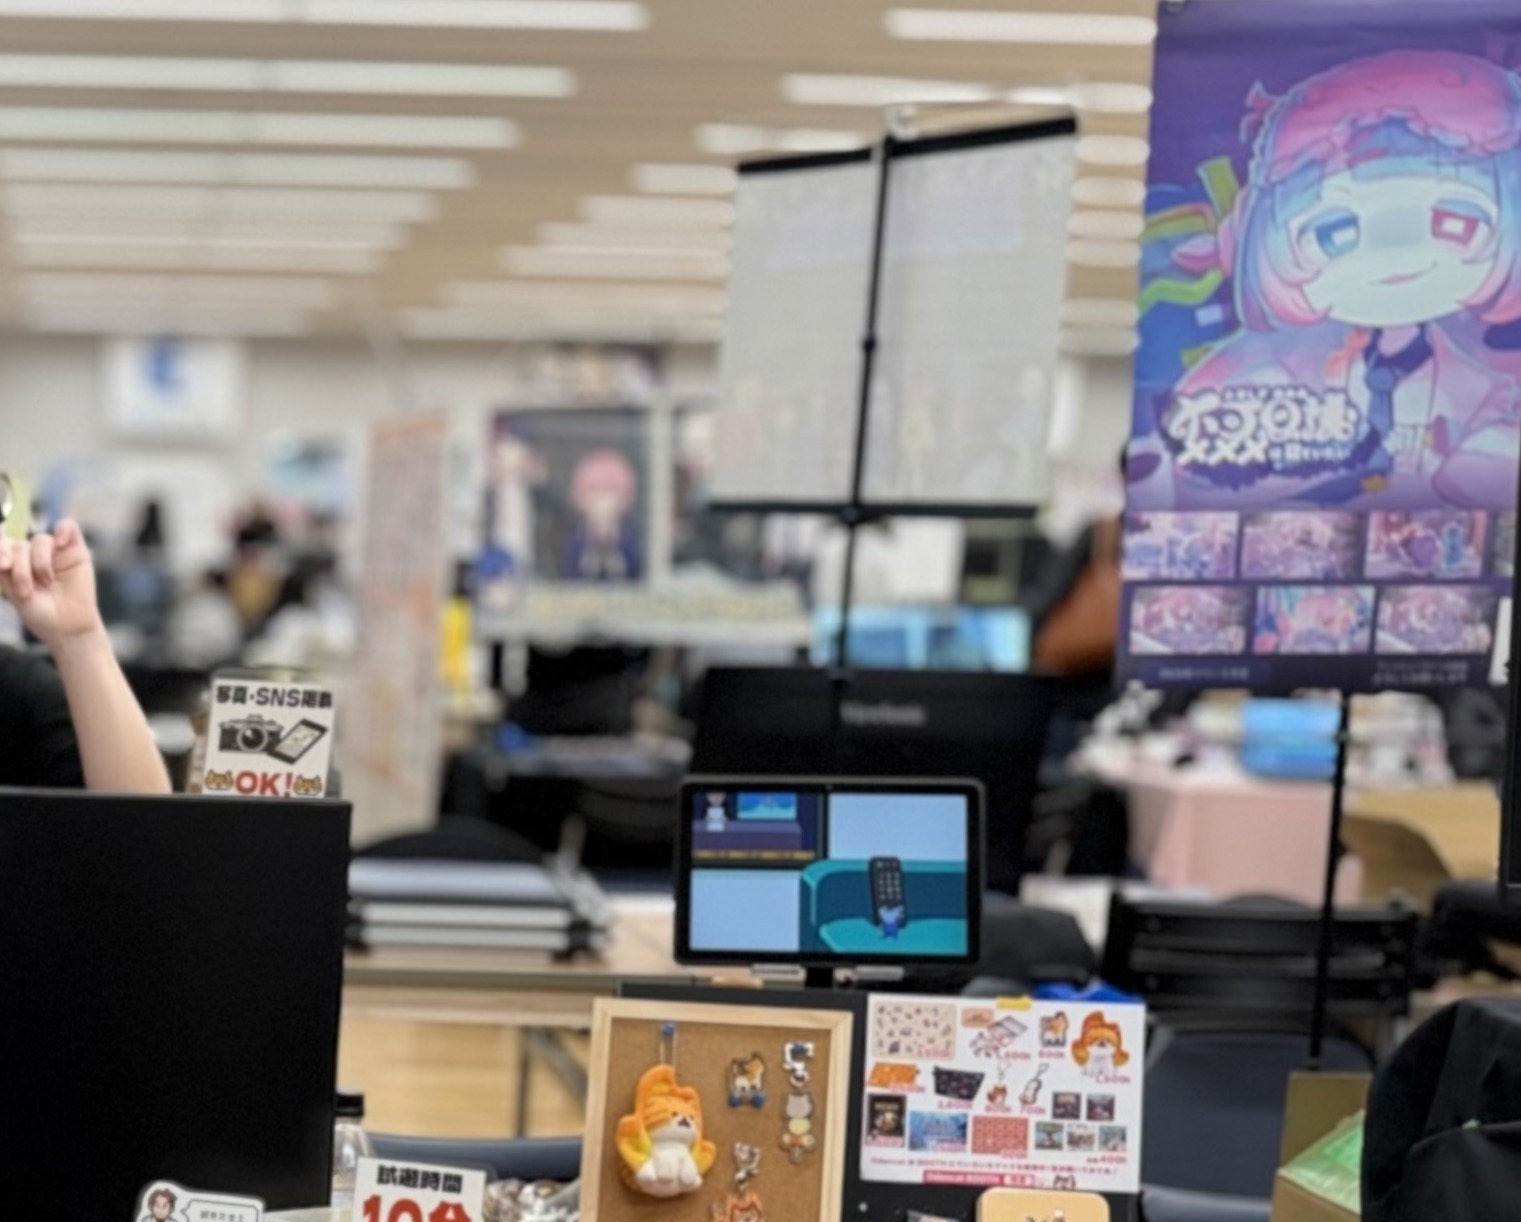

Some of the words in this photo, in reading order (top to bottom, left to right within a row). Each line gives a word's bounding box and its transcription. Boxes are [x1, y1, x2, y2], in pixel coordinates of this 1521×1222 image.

[235, 771, 294, 798] OK!
[376, 1164, 464, 1194] 試遊時間
